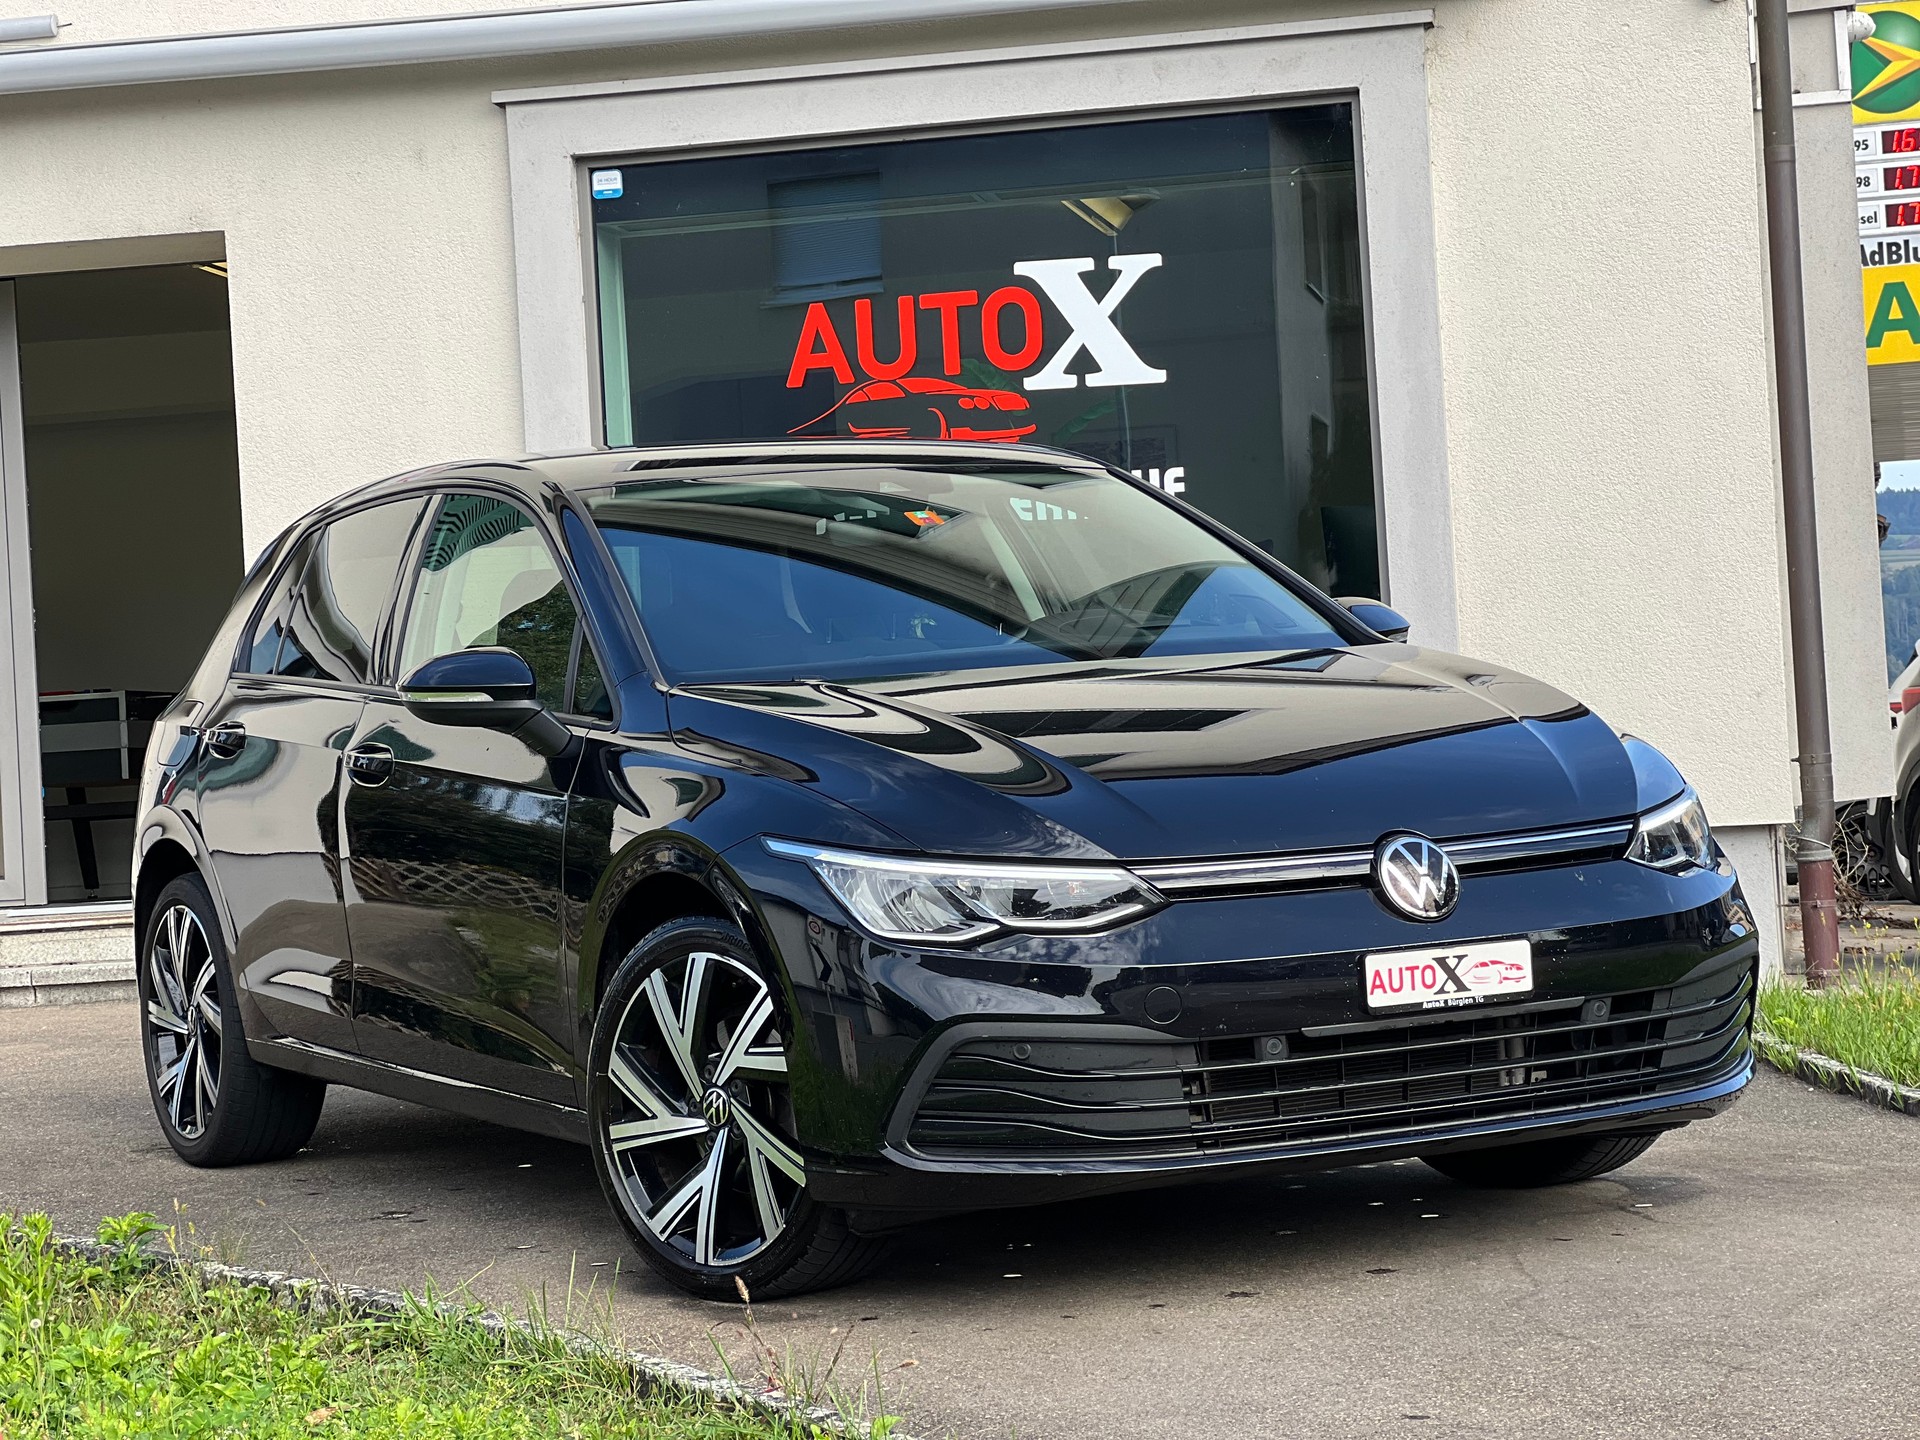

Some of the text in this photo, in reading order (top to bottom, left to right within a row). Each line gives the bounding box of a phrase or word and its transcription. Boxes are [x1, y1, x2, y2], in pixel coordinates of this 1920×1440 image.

[1854, 128, 1920, 152] 95 1.6
[1856, 176, 1871, 188] 98
[1859, 211, 1878, 225] sel
[1475, 995, 1484, 1003] TG
